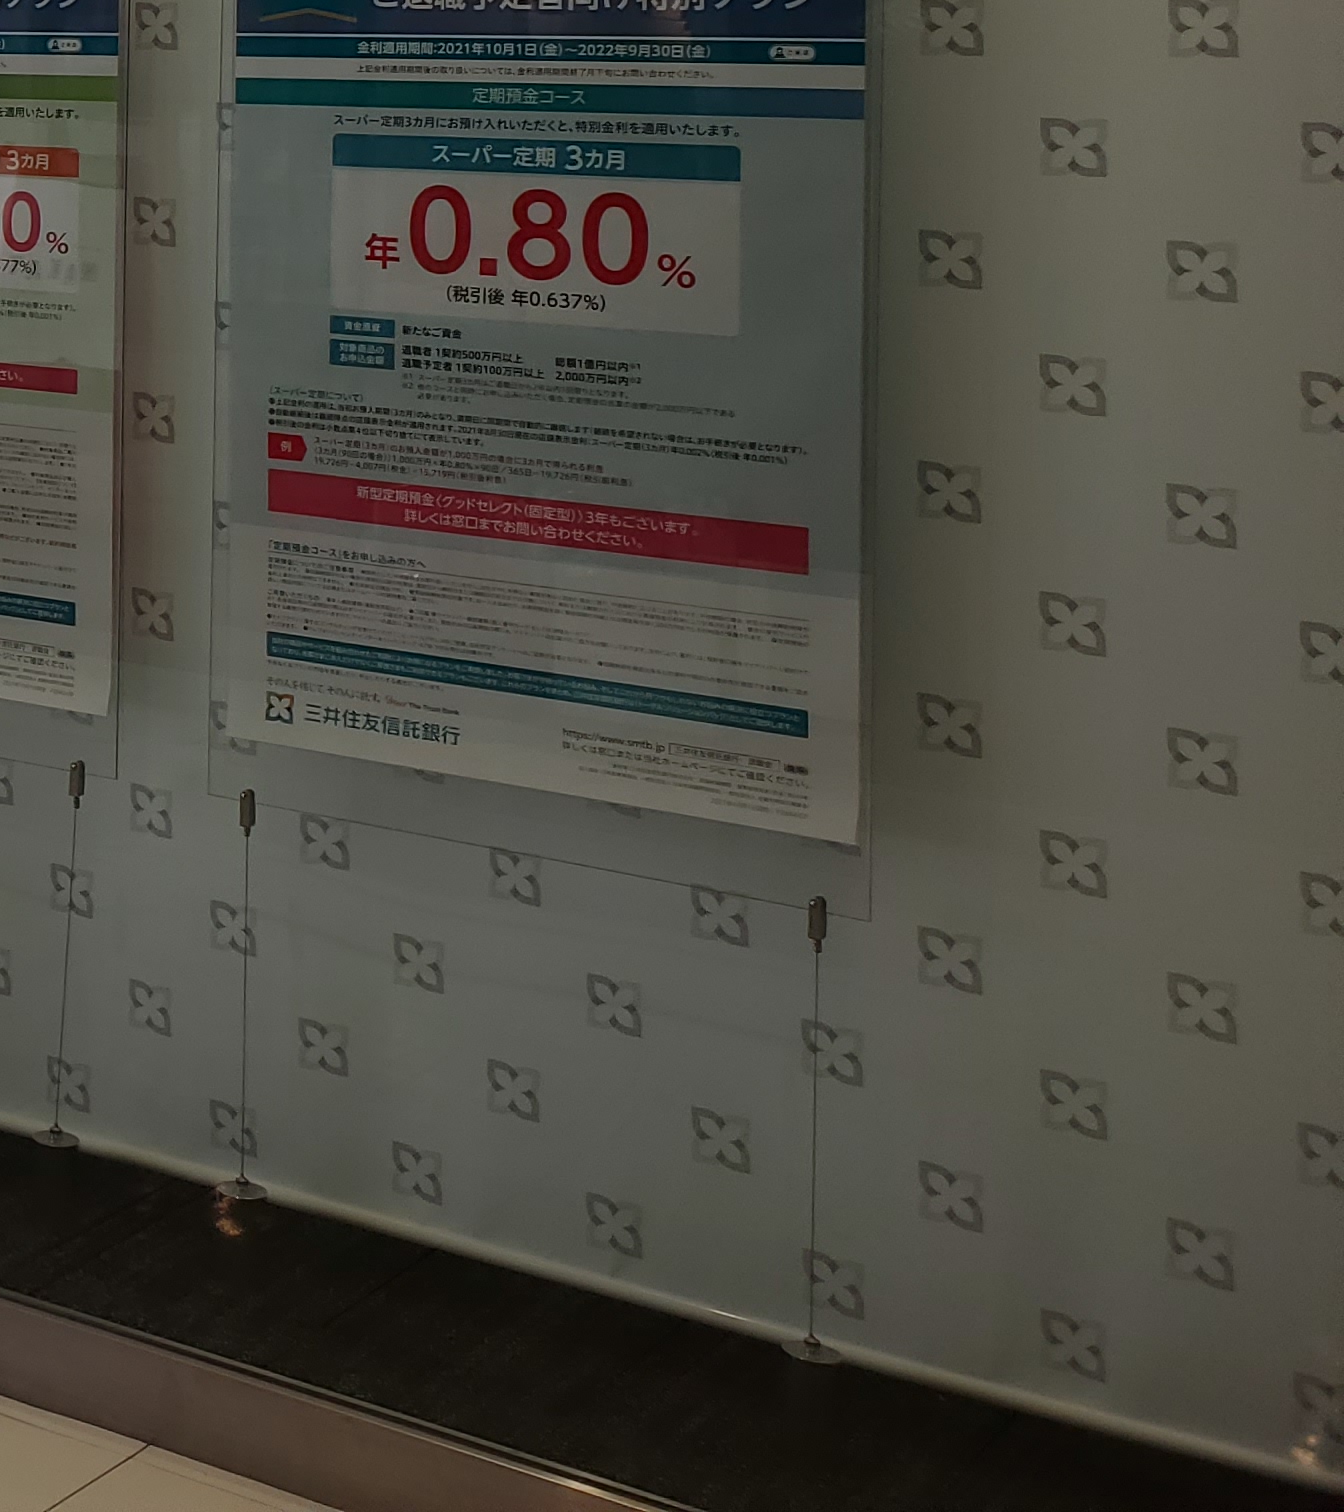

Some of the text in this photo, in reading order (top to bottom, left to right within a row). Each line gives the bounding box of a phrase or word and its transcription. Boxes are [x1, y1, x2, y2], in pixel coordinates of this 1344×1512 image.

[472, 87, 586, 106] 定期預金コース
[432, 144, 556, 169] スーパー定期
[402, 325, 463, 340] 新たなご資金
[304, 702, 461, 746] 三井住友信託銀行
[562, 727, 666, 754] https://www.smtb.jp
